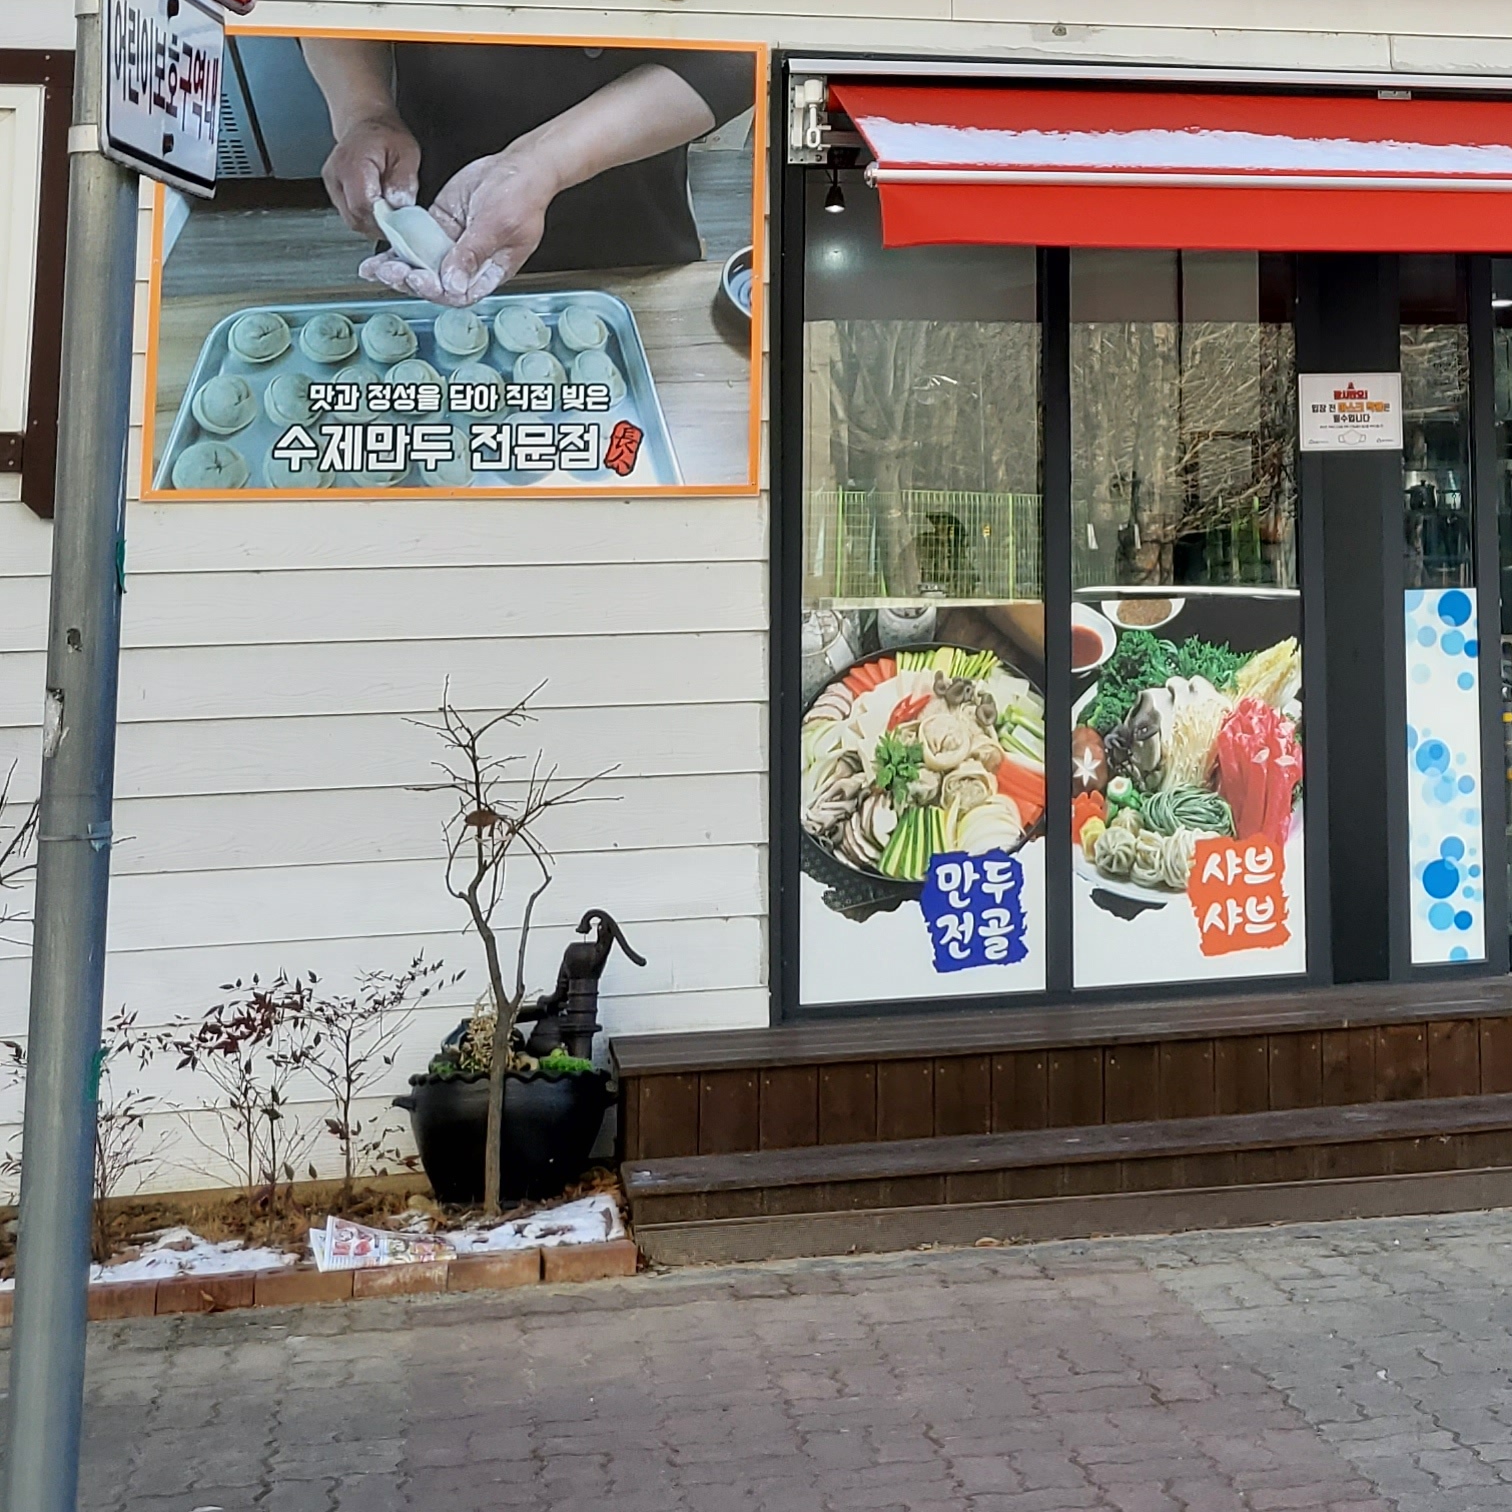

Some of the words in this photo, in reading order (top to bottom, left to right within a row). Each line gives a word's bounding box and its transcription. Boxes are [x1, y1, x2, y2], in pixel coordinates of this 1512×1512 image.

[307, 384, 361, 413] 맛과
[367, 385, 442, 412] 정성을
[449, 384, 500, 413] 담아
[506, 383, 555, 411] 직접
[561, 384, 611, 411] 빚은
[272, 422, 455, 473] 수제만두
[469, 423, 600, 472] 전문점
[935, 859, 1017, 908] 만두
[1201, 845, 1275, 886] 샤브
[938, 907, 1015, 960] 전골
[1202, 895, 1277, 936] 샤브
